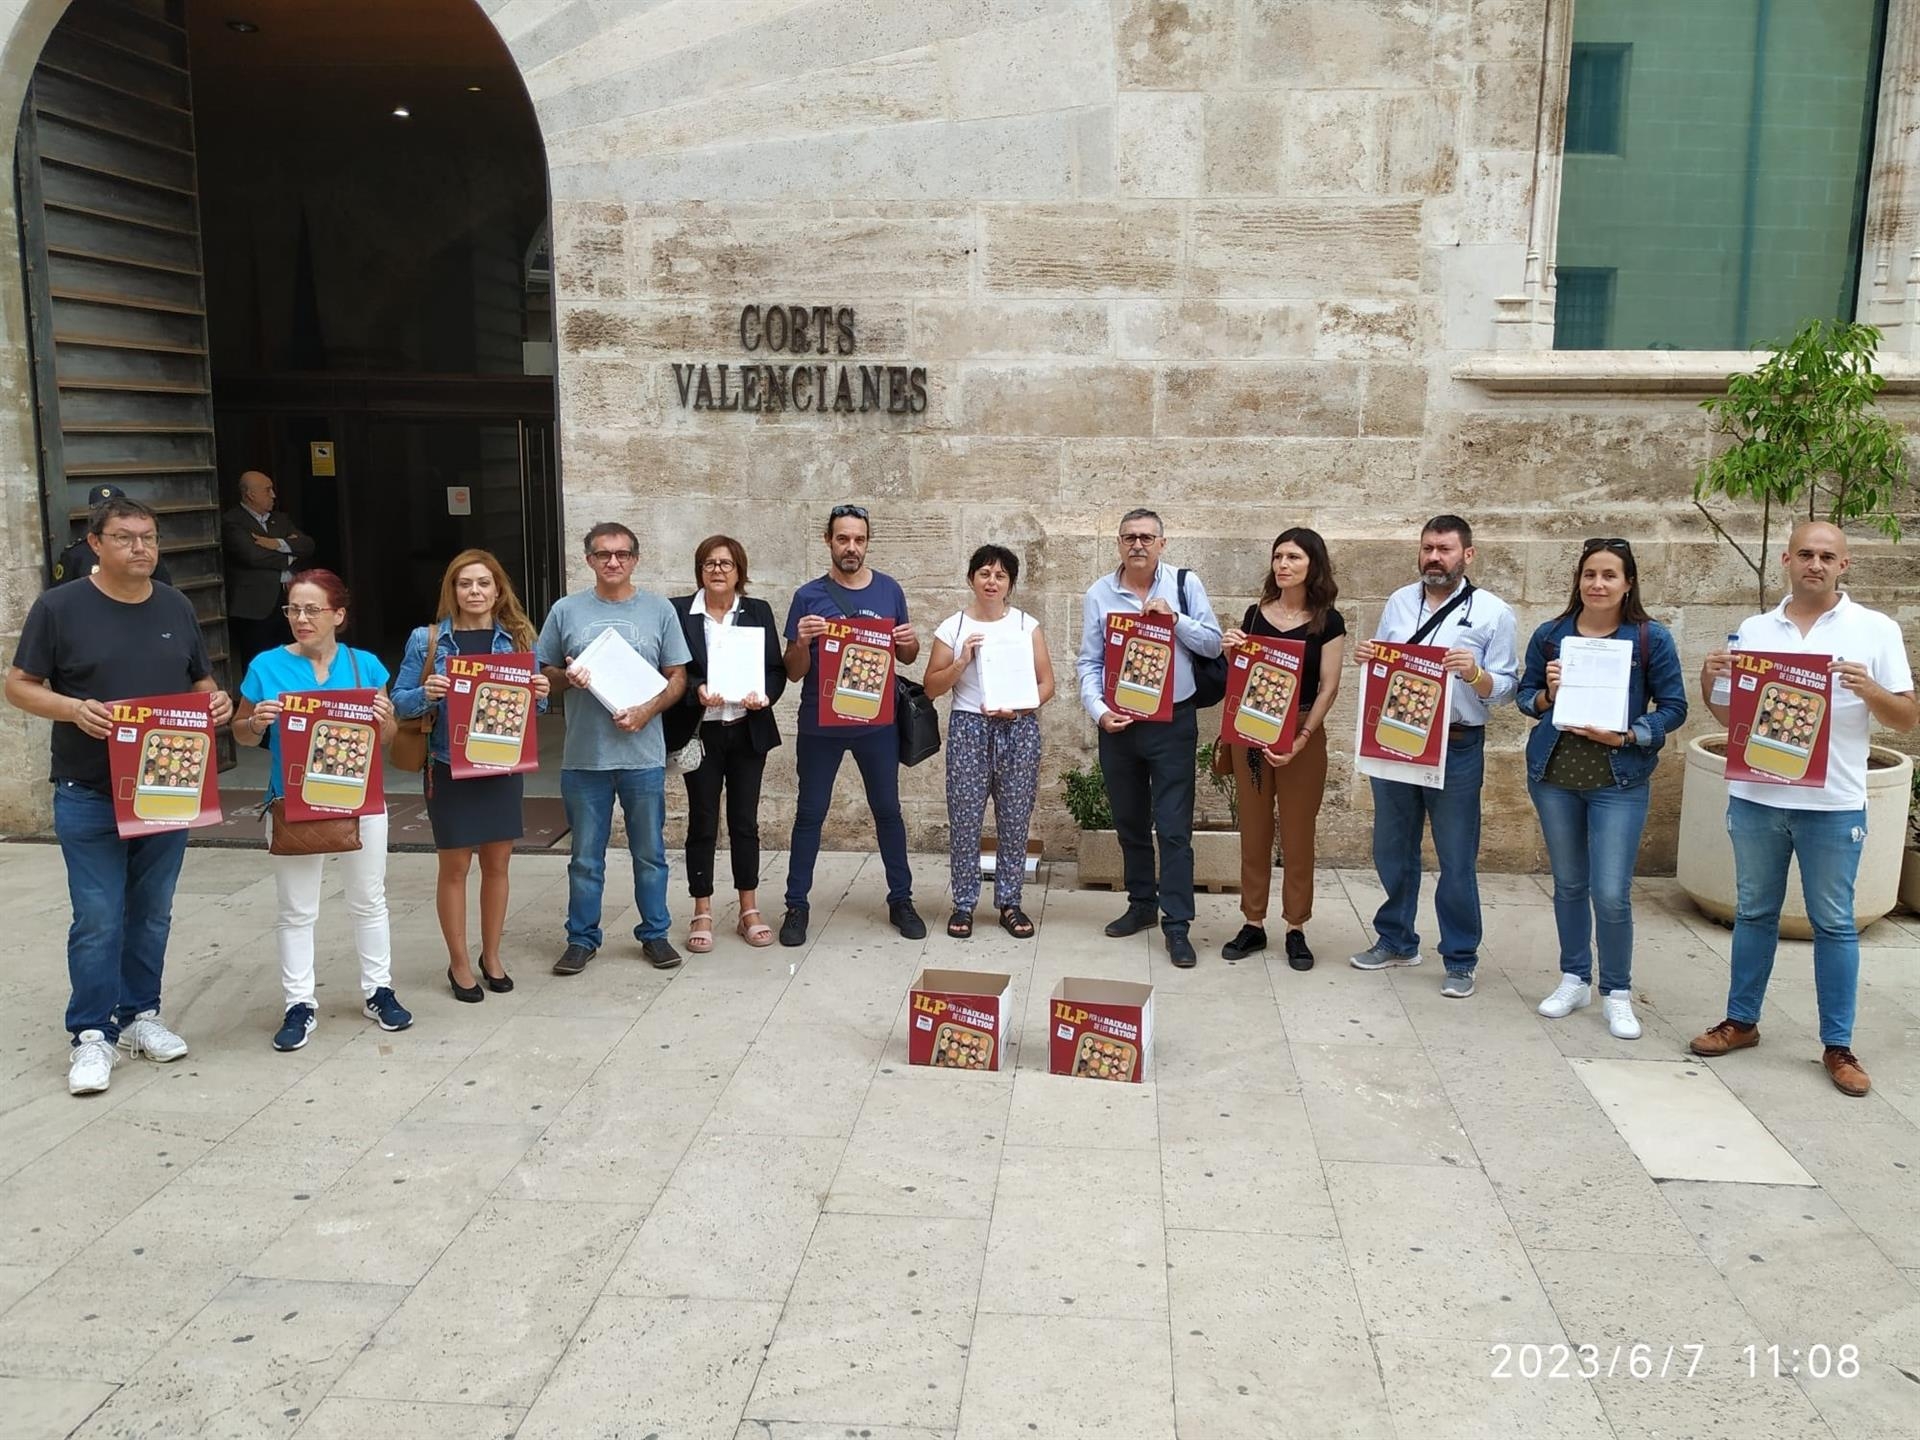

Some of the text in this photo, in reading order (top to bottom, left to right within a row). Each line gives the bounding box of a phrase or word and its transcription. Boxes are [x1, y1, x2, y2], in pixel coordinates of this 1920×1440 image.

[740, 304, 856, 355] CORTS
[671, 362, 928, 413] VALENCIANES
[1110, 615, 1134, 632] ILP
[1374, 644, 1401, 664] ILP
[451, 659, 485, 677] ILP
[500, 666, 531, 677] BAIXADA
[1736, 654, 1774, 674] ILP
[1774, 663, 1783, 672] PER
[1790, 667, 1827, 682] BAIXADA
[1779, 672, 1785, 680] DE
[113, 705, 152, 724] ILP
[170, 710, 208, 720] BAIXADA
[284, 695, 321, 714] ILP
[914, 994, 948, 1015] ILP
[962, 1007, 995, 1022] BAIXADA
[1055, 1003, 1088, 1025] ILP
[1104, 1017, 1137, 1032] BAIXADA
